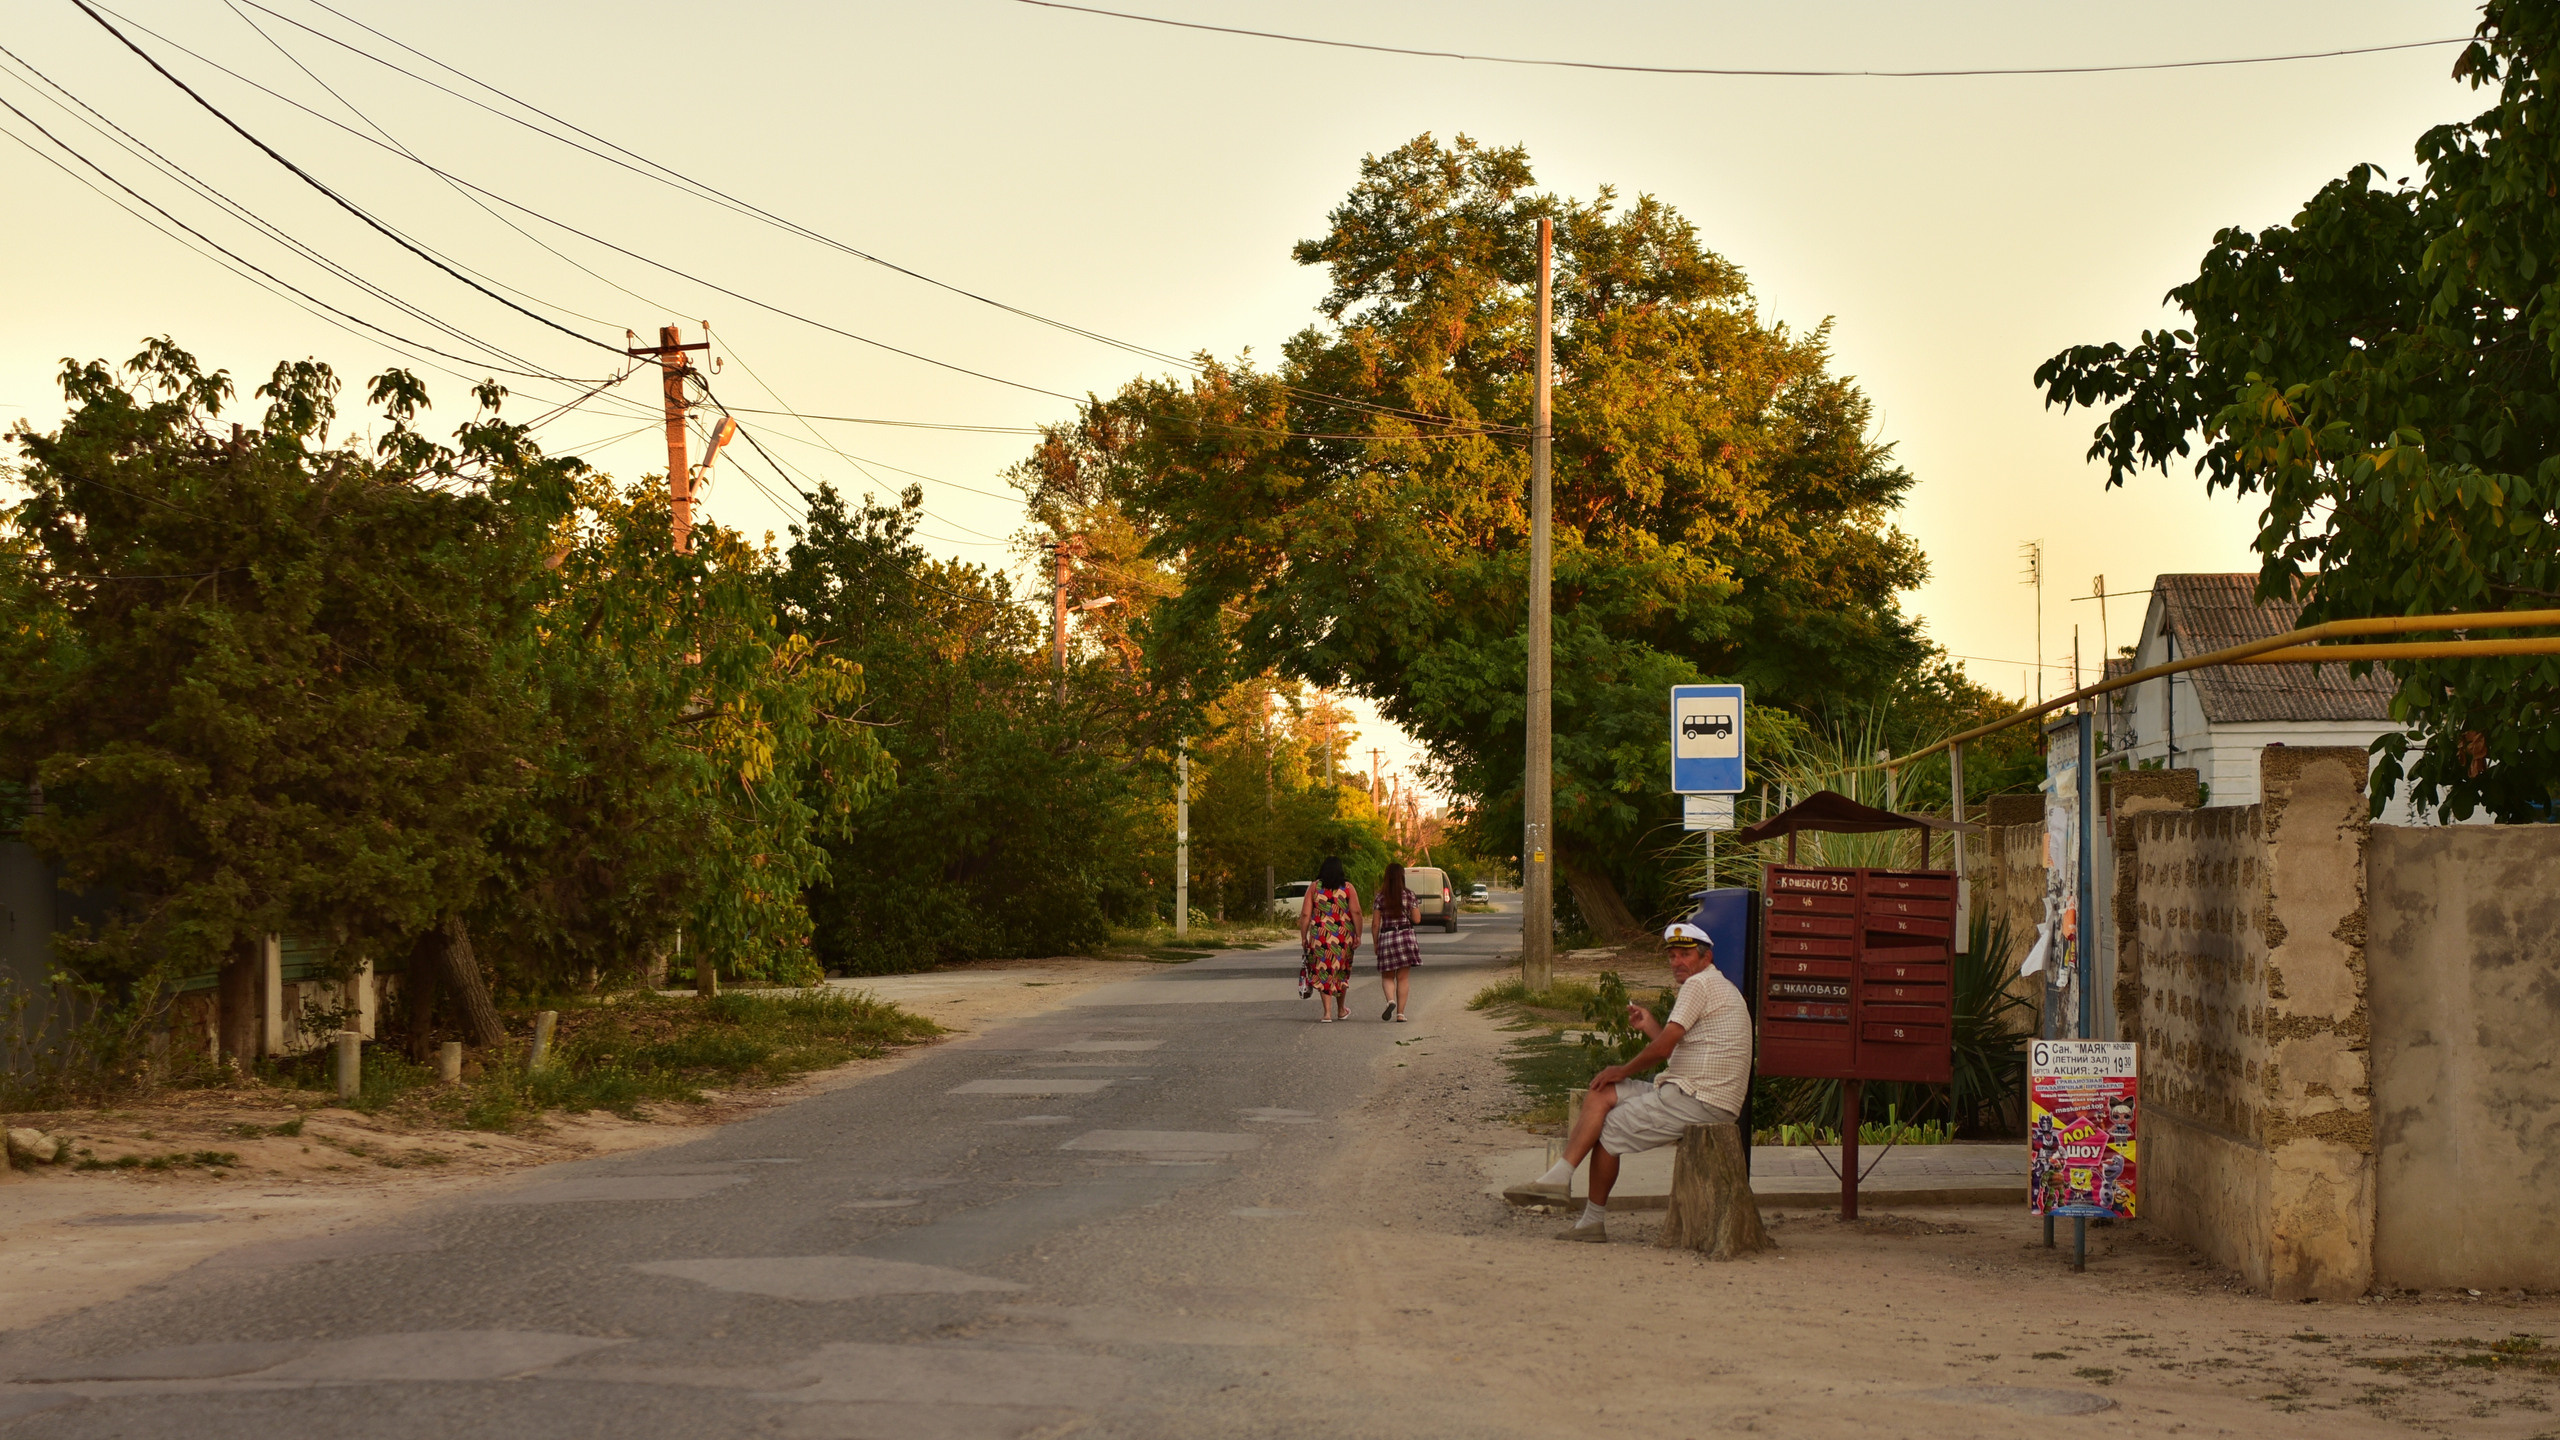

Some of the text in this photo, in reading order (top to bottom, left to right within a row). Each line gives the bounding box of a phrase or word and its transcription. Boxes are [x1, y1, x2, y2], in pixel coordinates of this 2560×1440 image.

[1781, 876, 1848, 892] КОШЕВОГО 36
[1783, 983, 1847, 996] ЧКАЛОВА 50
[2034, 1042, 2049, 1066] 6
[2052, 1043, 2072, 1054] Сан.
[2052, 1055, 2110, 1064] (ЛЕТНИЙ ЗАЛ)
[2053, 1066, 2109, 1076] АКЦИЯ: 2+1
[2055, 1103, 2104, 1113] maskarad.top
[2063, 1125, 2096, 1145] ЛОЛ
[2066, 1145, 2101, 1159] ШОУ
